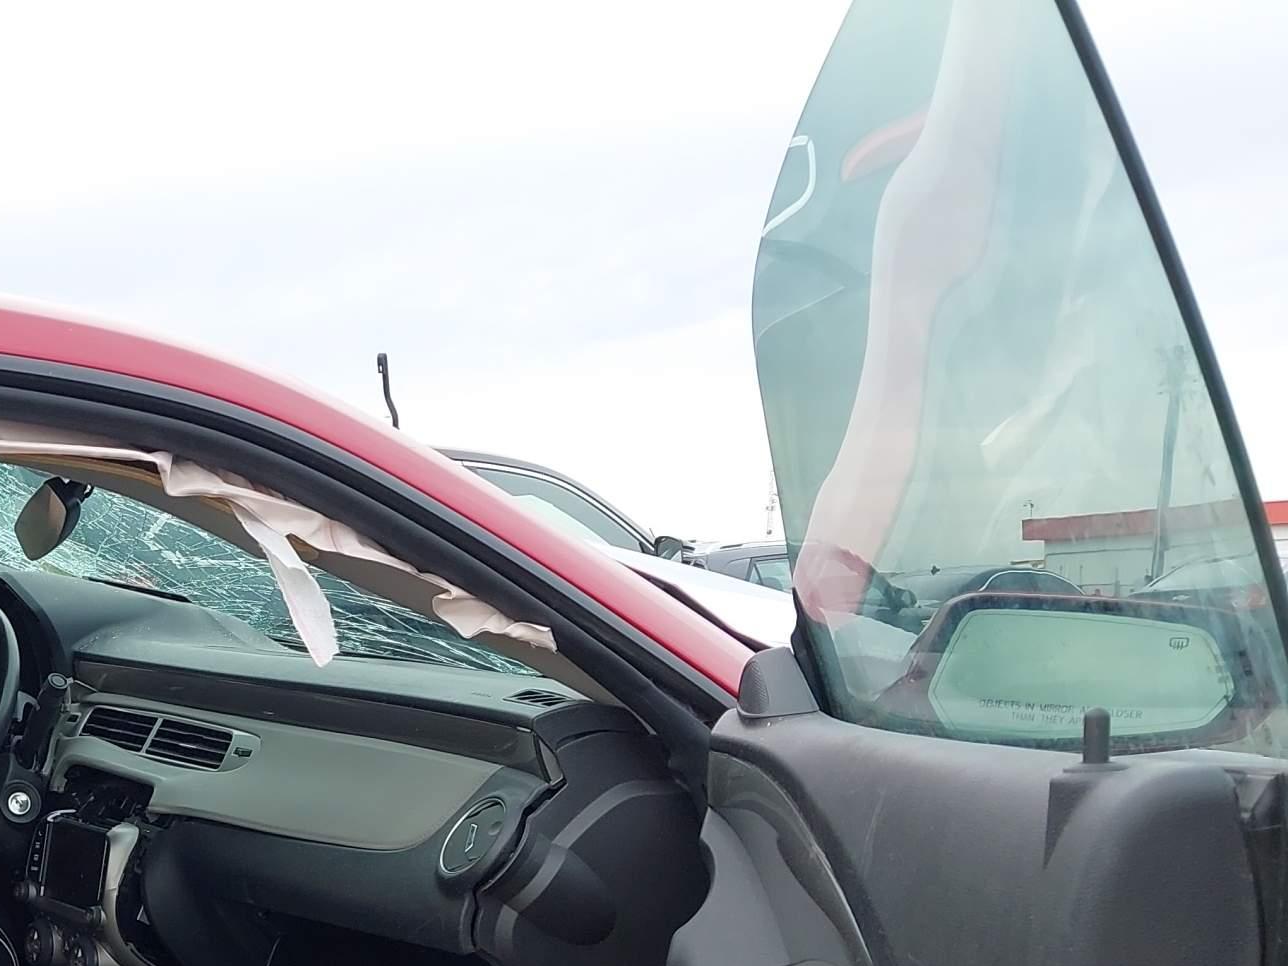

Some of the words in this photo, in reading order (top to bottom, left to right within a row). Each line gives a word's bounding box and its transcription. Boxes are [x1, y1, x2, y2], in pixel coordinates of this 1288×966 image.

[979, 699, 1021, 709] OBJECTS
[1025, 703, 1035, 711] IN
[1110, 708, 1143, 718] LOSER
